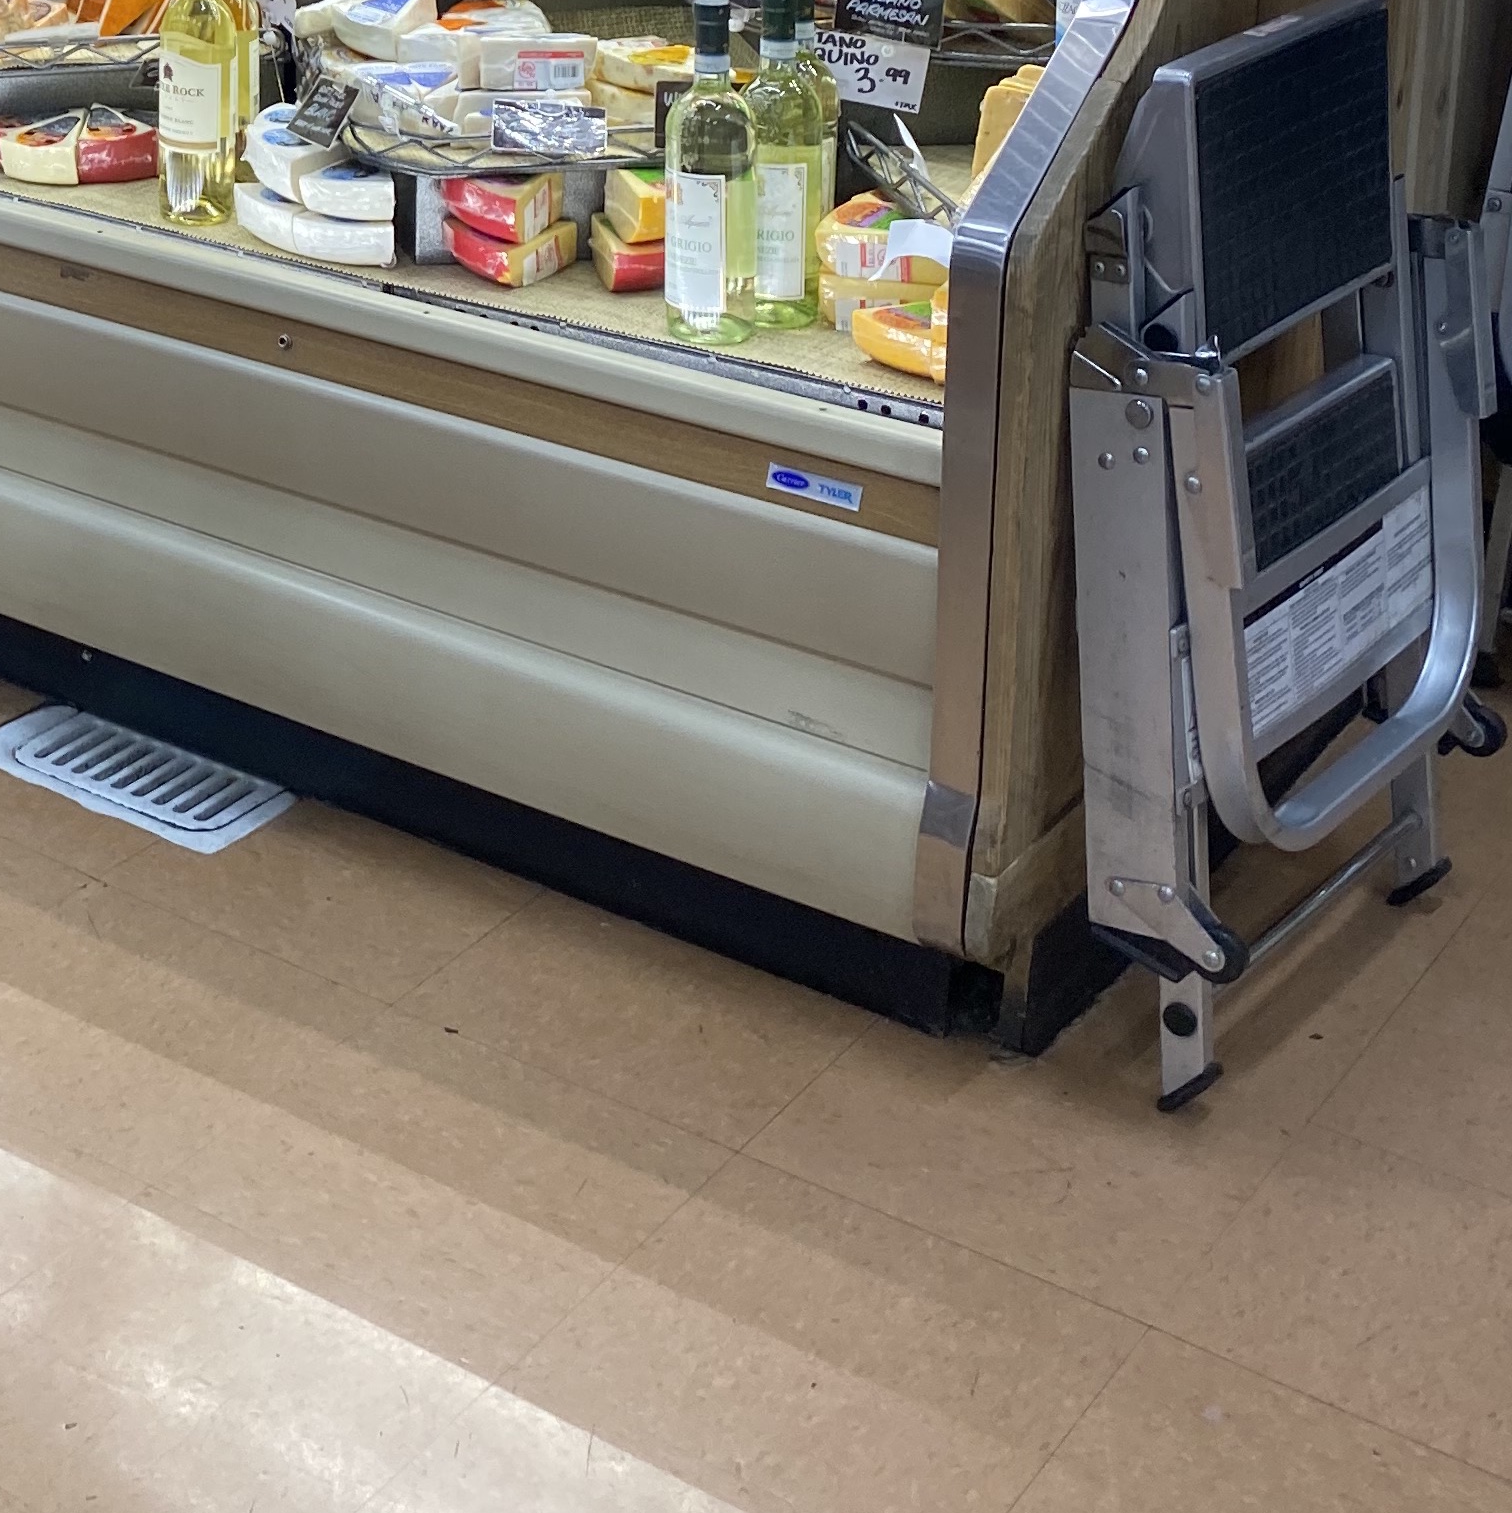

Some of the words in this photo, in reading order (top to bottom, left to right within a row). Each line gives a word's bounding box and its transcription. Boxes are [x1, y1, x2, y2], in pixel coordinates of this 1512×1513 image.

[845, 0, 929, 26] PARMESAN
[173, 86, 204, 97] ROCK
[854, 67, 911, 94] 3.99
[670, 236, 712, 254] GRIGIO
[756, 229, 795, 242] RIGIO
[776, 473, 805, 487] Carrier
[818, 483, 853, 504] TYLER
